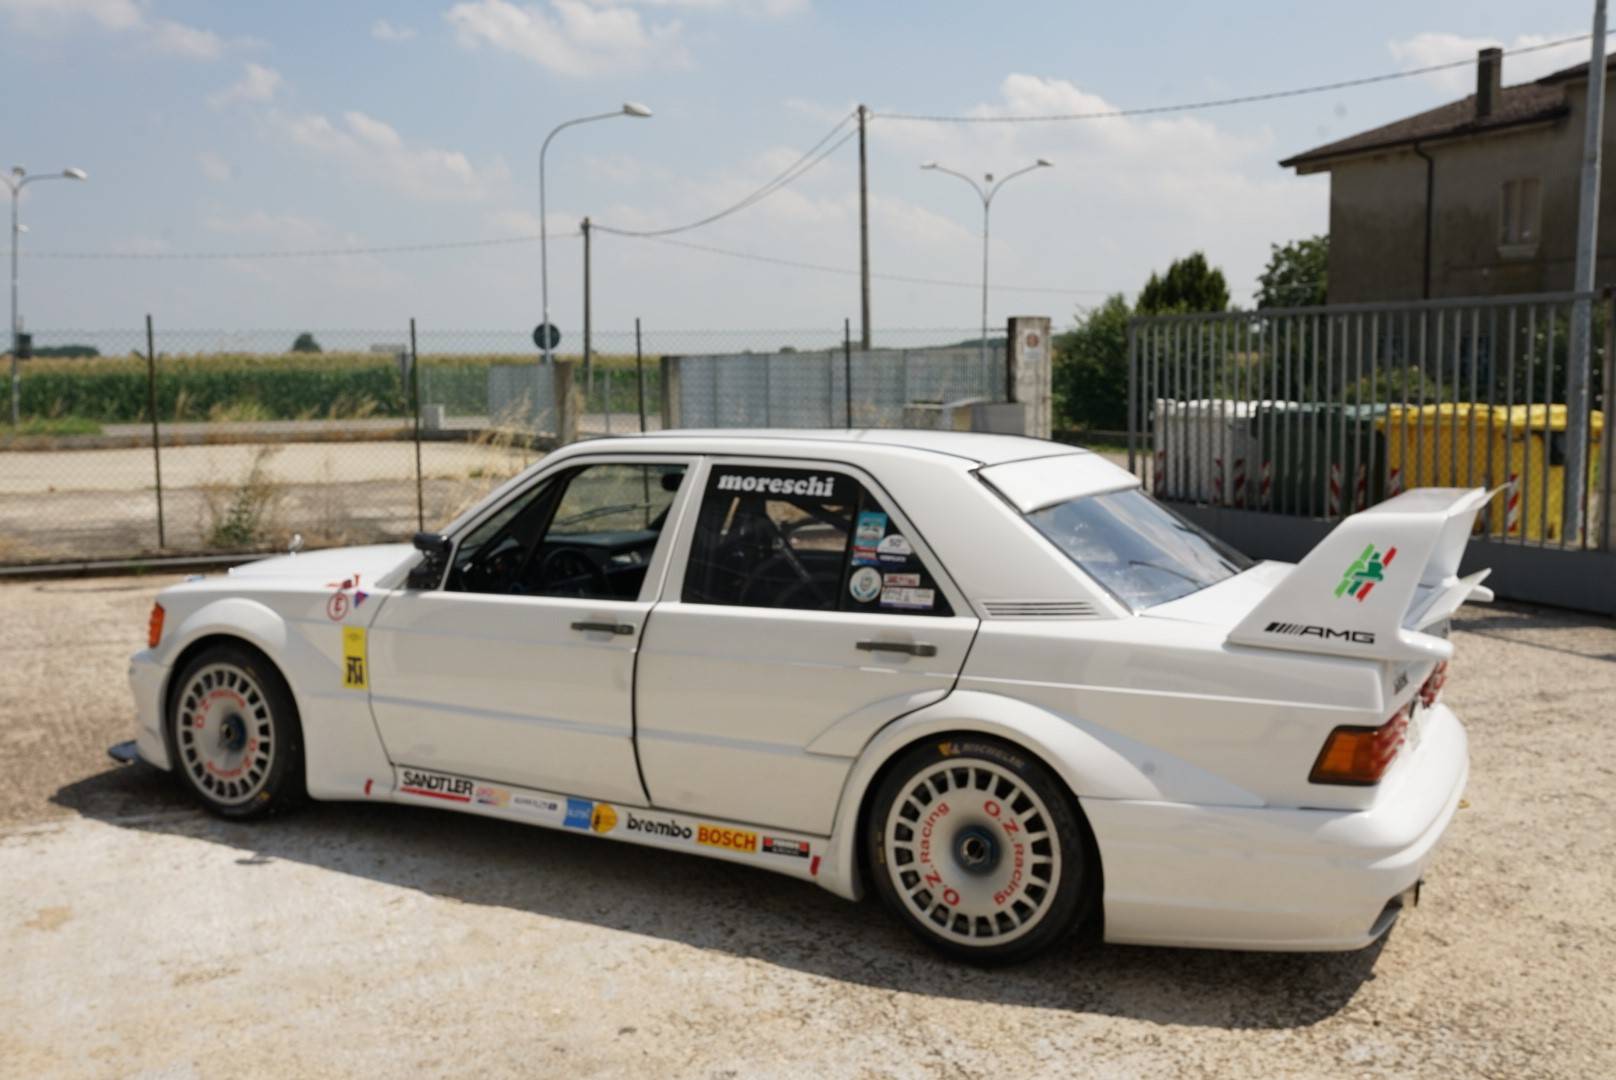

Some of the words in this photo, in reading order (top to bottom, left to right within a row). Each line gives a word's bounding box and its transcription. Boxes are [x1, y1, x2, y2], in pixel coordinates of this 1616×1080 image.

[717, 474, 835, 497] moreschi
[1299, 625, 1376, 645] AMG
[402, 770, 474, 796] SANDTLER
[627, 812, 693, 840] brembo
[697, 826, 757, 851] BOSCH
[918, 801, 951, 865] Racing
[993, 842, 1025, 907] Racing
